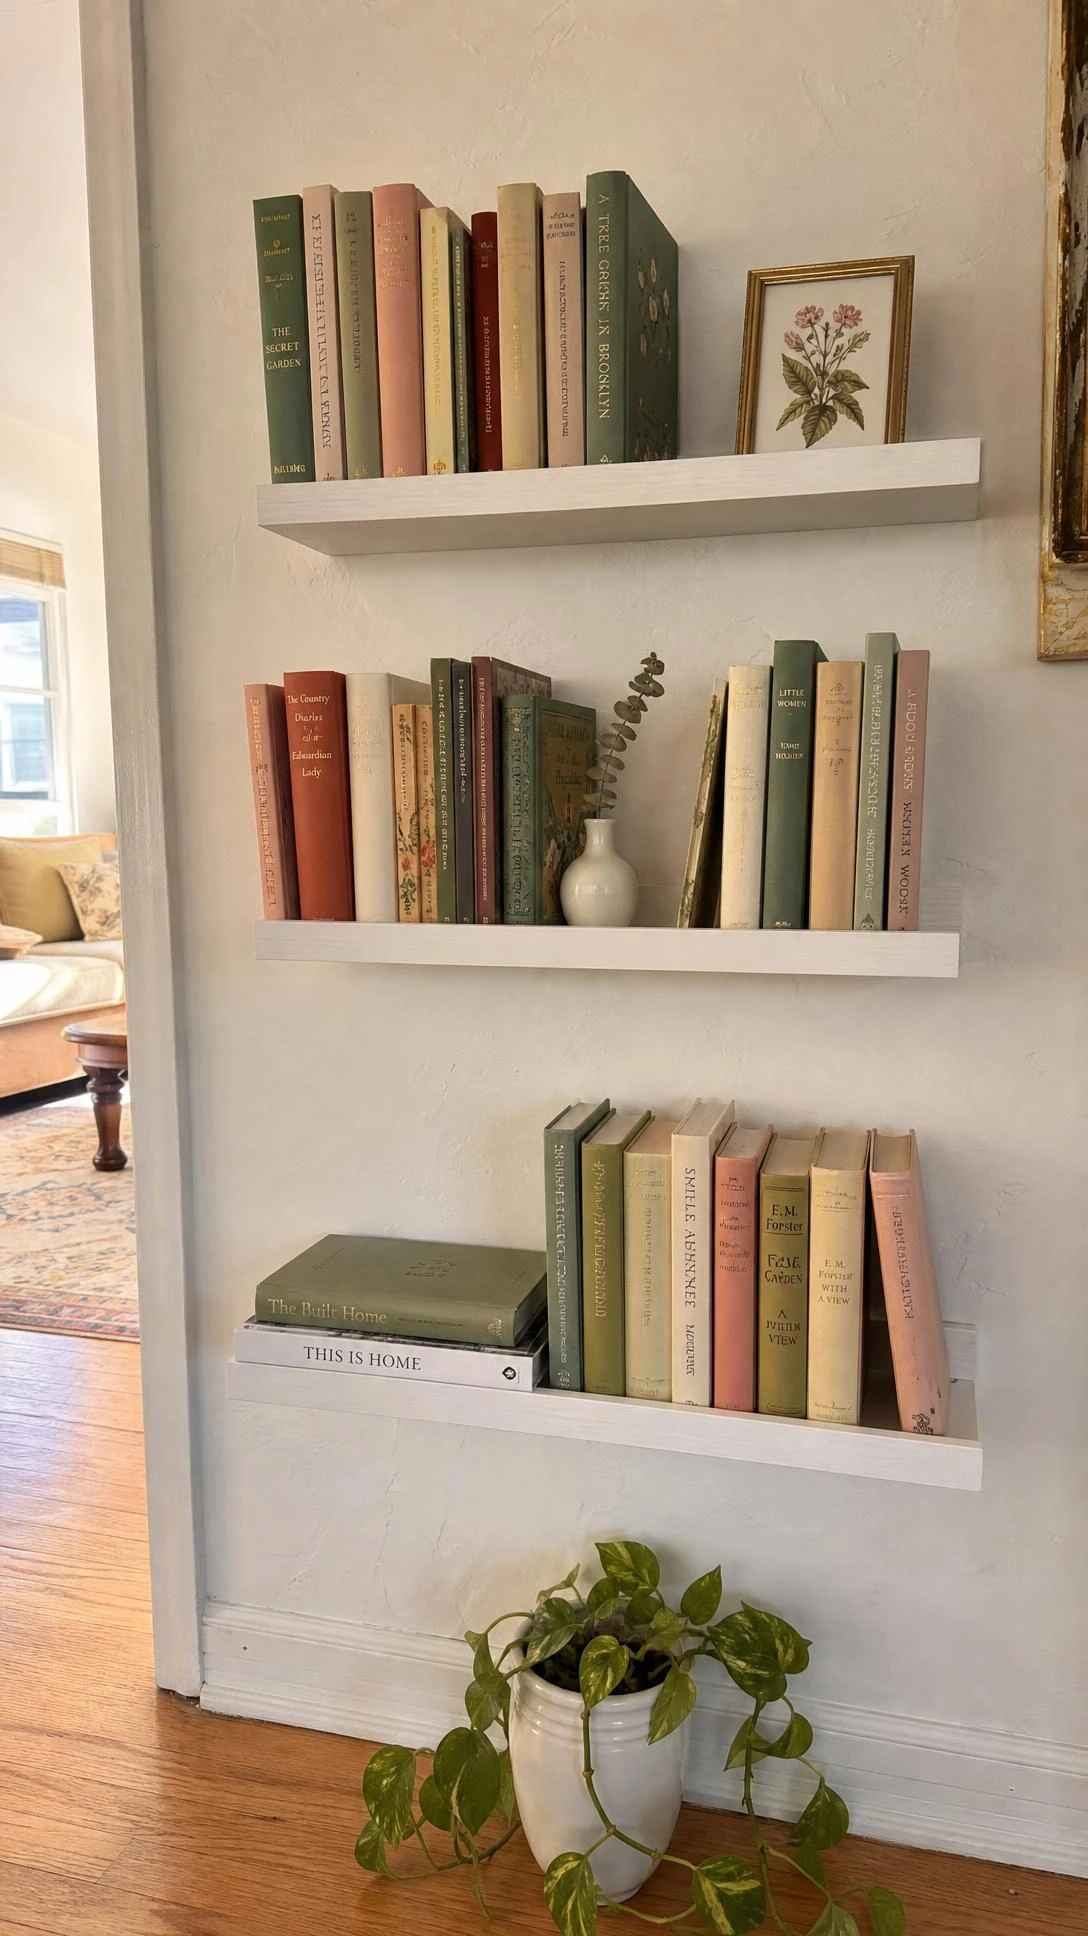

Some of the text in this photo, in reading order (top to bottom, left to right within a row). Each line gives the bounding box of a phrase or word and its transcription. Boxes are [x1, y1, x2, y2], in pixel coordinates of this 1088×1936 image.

[599, 194, 609, 204] A
[598, 213, 610, 253] TREE
[272, 327, 291, 337] THE
[265, 341, 301, 354] SECRET
[266, 358, 302, 370] GARDEN
[287, 693, 330, 705] The Country
[779, 689, 805, 697] LITTLE
[777, 700, 806, 708] WOMEN
[302, 766, 322, 778] Lady
[766, 1218, 804, 1232] Forster
[822, 1284, 847, 1293] WITH
[818, 1295, 851, 1305] A VIEW
[268, 1298, 297, 1316] The
[302, 1301, 338, 1320] Built
[343, 1306, 388, 1325] Home
[304, 1346, 421, 1371] THIS IS HOME
